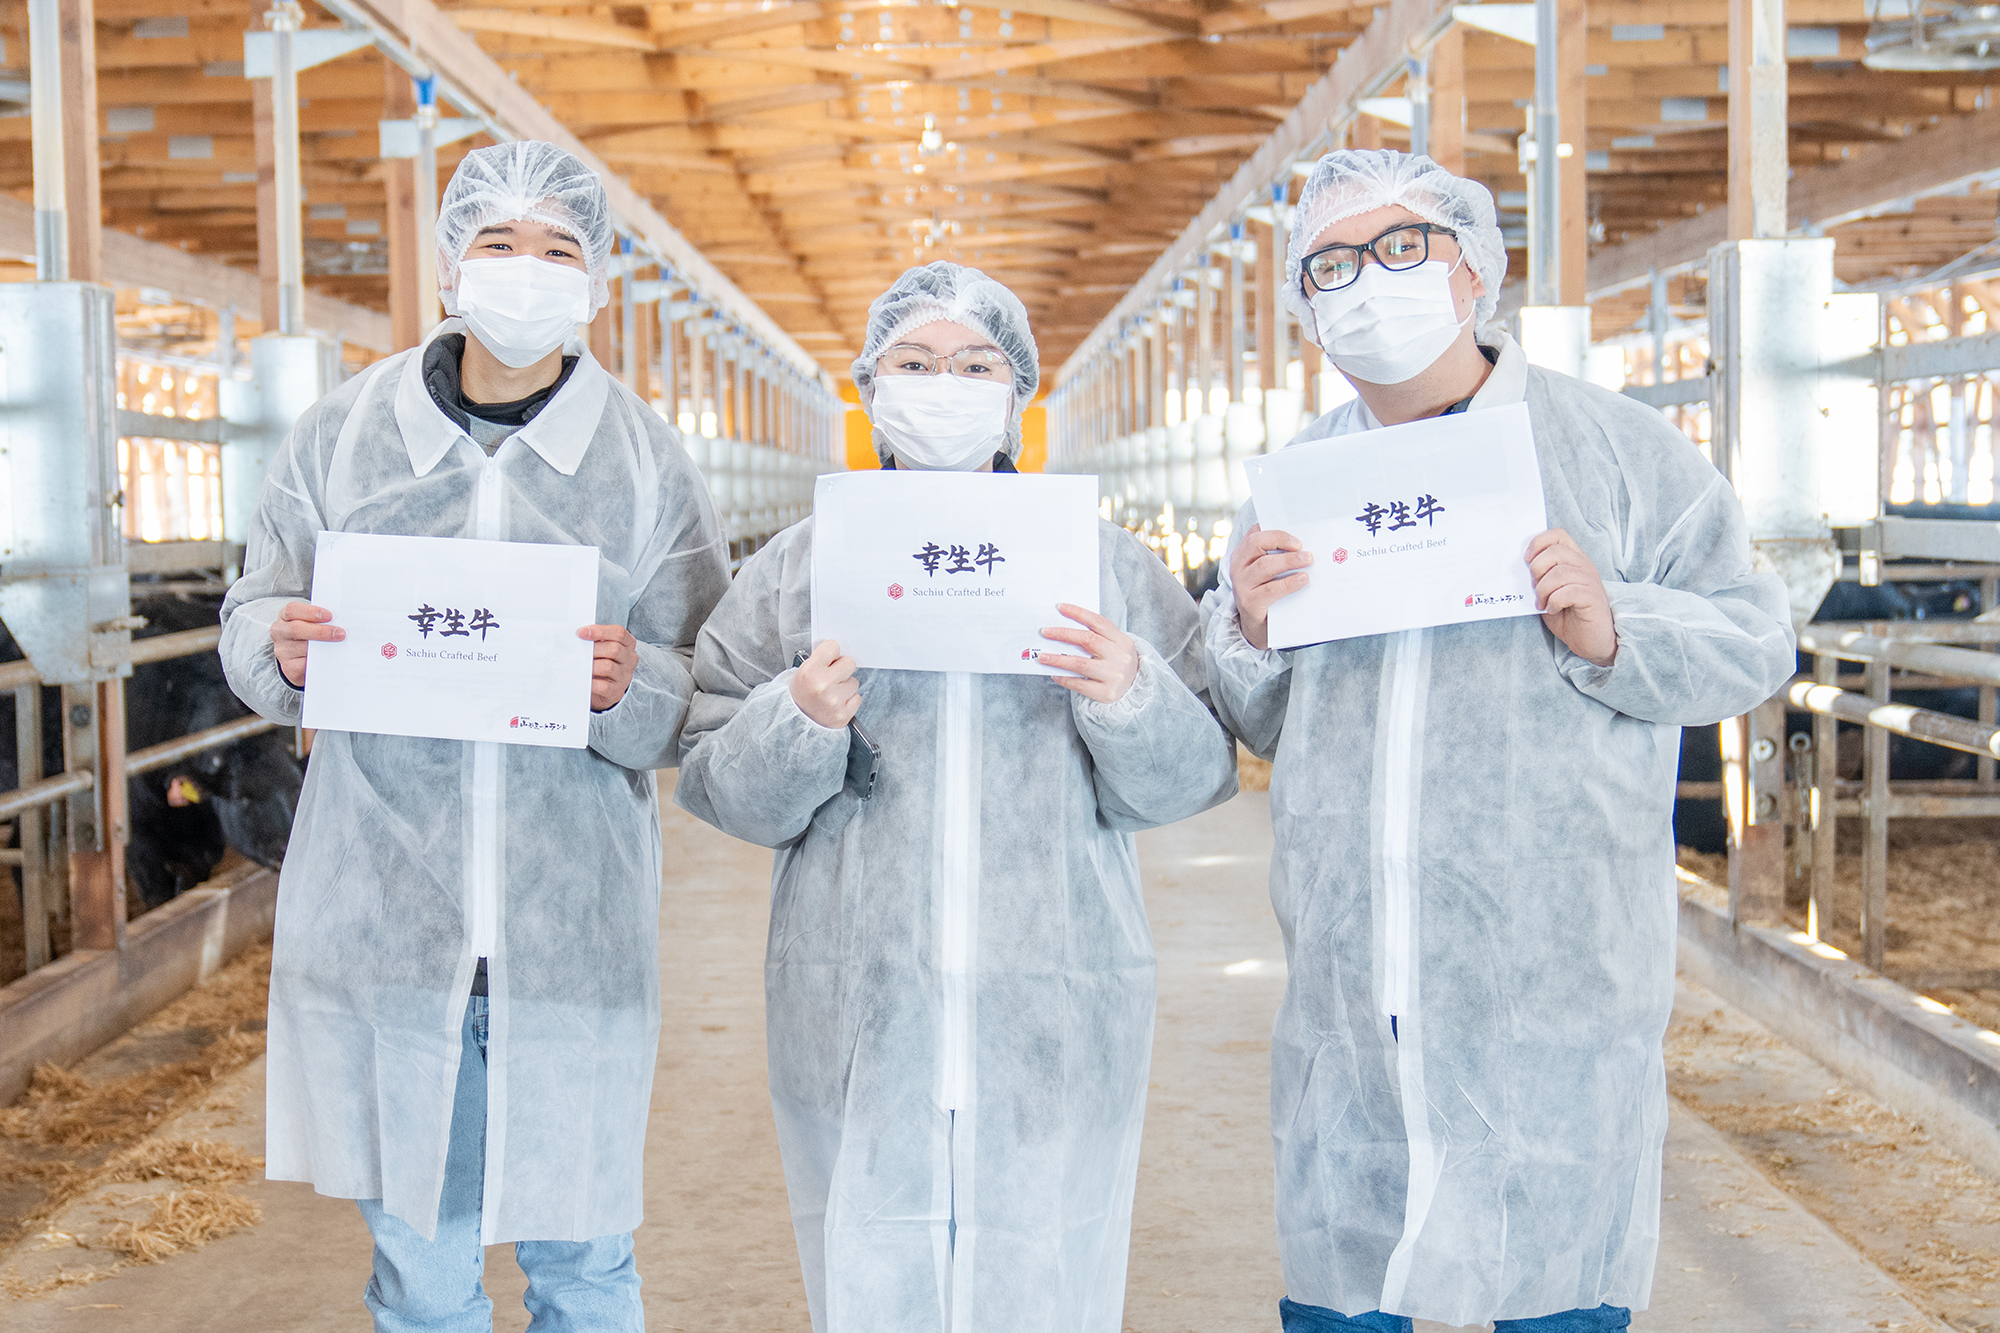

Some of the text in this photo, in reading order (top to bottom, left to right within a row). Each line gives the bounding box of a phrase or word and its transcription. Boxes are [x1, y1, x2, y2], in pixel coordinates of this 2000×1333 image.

[1355, 493, 1446, 538] 幸生牛
[912, 541, 1006, 578] 幸生牛
[1356, 537, 1448, 558] Sachiu Crafted Beef
[912, 587, 1006, 597] Sachiu Crafted Beef
[407, 603, 501, 643] 幸生牛
[405, 647, 499, 662] Sachiu Crafted Beef
